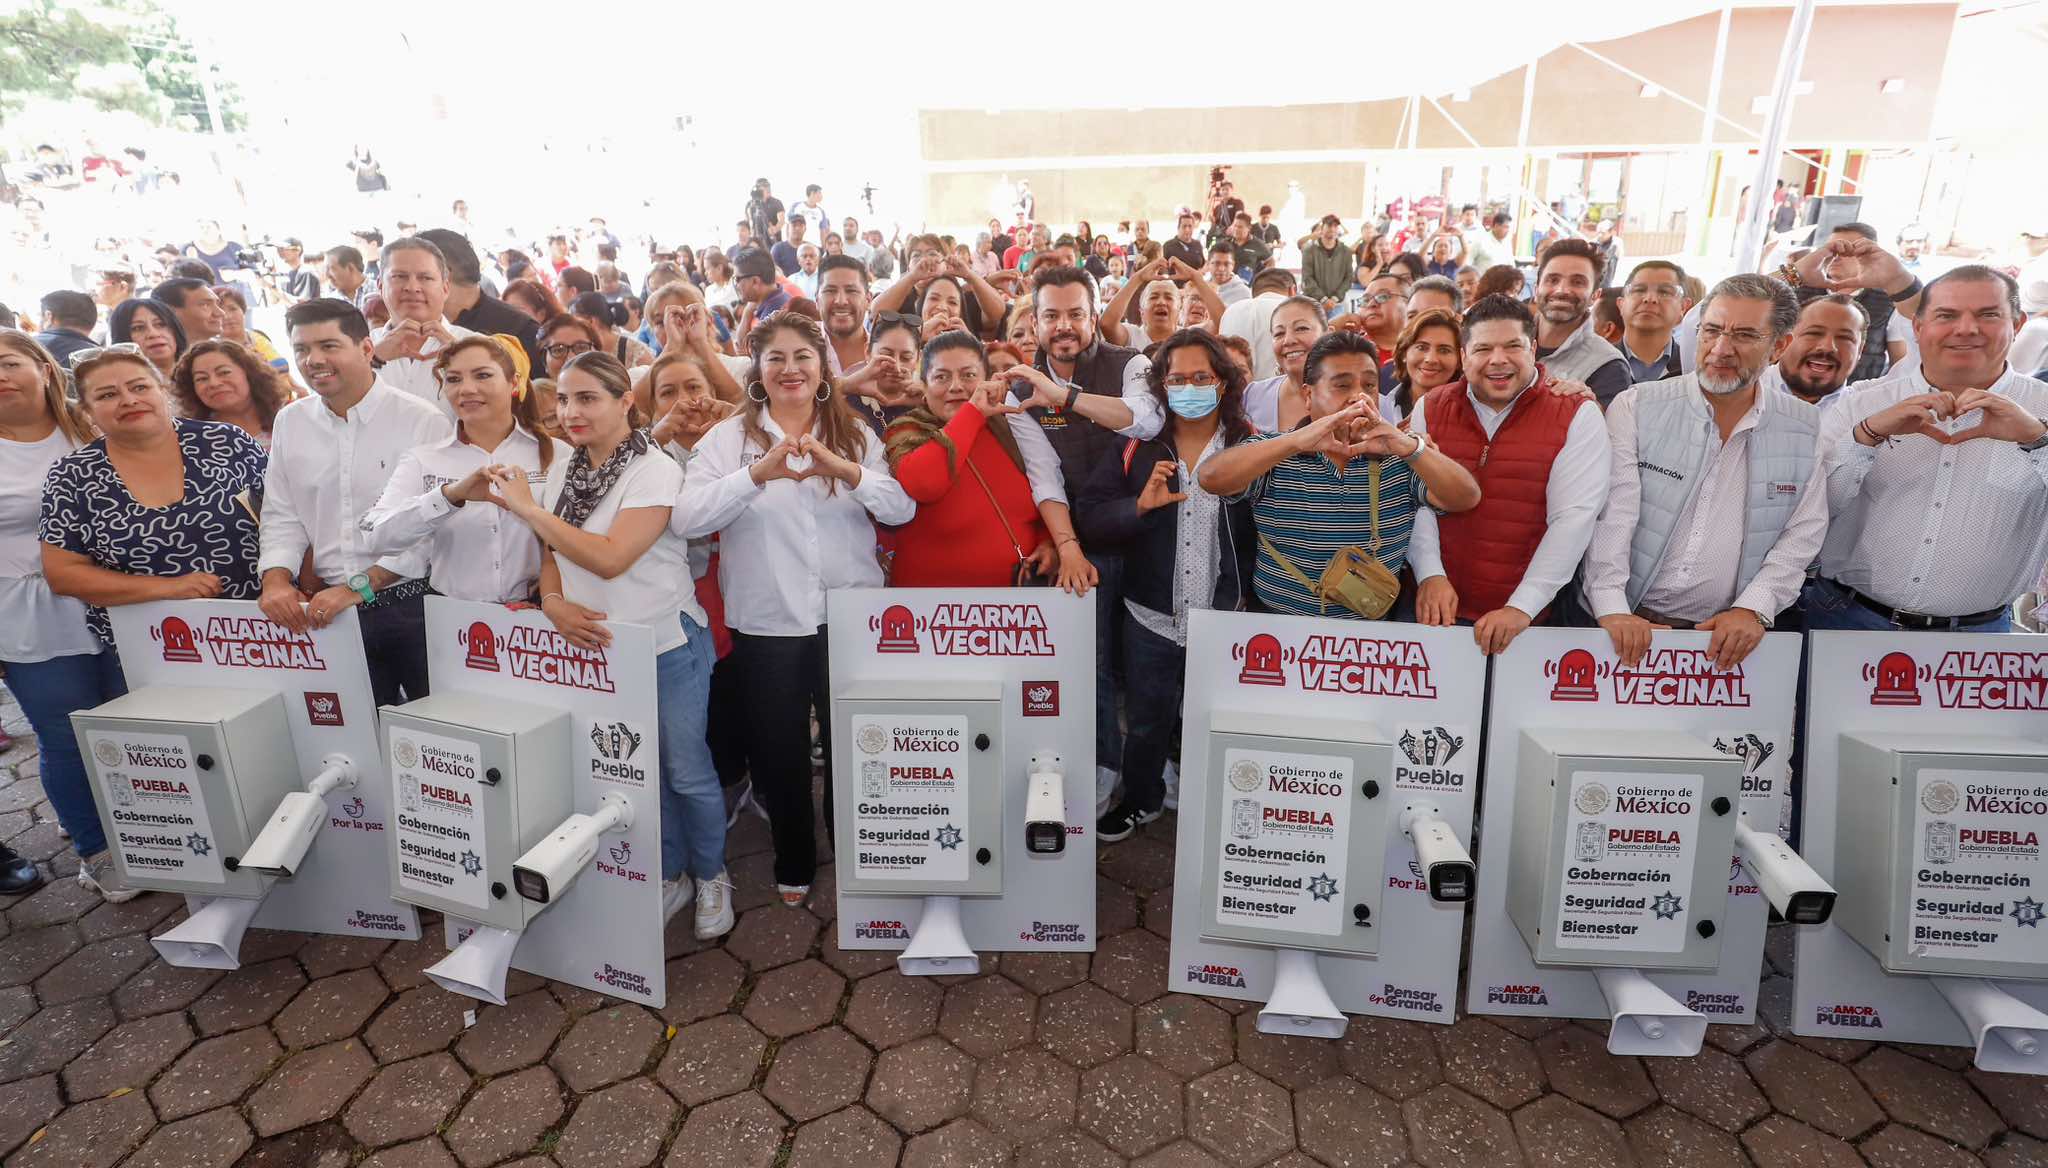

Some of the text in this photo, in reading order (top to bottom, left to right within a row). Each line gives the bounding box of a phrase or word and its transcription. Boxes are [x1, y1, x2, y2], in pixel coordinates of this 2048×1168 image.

[930, 604, 1047, 629] ALARMA
[931, 627, 1055, 655] VECINAL
[208, 639, 326, 670] VECINAL
[1299, 635, 1430, 670] ALARMA
[508, 649, 615, 693] VECINAL
[1934, 651, 2048, 679] ALARM
[1300, 660, 1437, 699] VECINAL
[1614, 675, 1750, 707] VECINAL
[1936, 678, 2048, 709] VECIN
[893, 728, 959, 736] Gobierno de
[124, 743, 183, 755] Gobierno de
[893, 737, 960, 752] México
[127, 752, 187, 768] México
[421, 745, 474, 763] Gobierno de
[422, 755, 474, 779] México
[592, 759, 644, 781] Puebla
[890, 767, 954, 780] PUEBLA
[1269, 765, 1343, 780] Gobierno de
[1396, 767, 1464, 786] Puebla
[1741, 776, 1772, 791] bla
[131, 778, 189, 793] PUEBLA
[1268, 775, 1342, 796] México
[1617, 786, 1692, 797] Gobierno de
[1966, 785, 2048, 797] Gobierno de
[421, 784, 472, 806] PUEBLA
[858, 803, 950, 815] Gobernación
[1616, 797, 1691, 814] México
[1965, 795, 2048, 815] México
[113, 810, 193, 825] Gobernación
[1263, 808, 1333, 826] PUEBLA
[332, 818, 384, 832] Por la paz
[399, 814, 470, 840] Gobernación
[1262, 821, 1296, 830] Gobierno
[1309, 825, 1334, 833] Estado
[120, 833, 182, 846] Seguridad
[859, 829, 930, 842] Seguridad
[1608, 829, 1680, 844] PUEBLA
[1959, 829, 2039, 845] PUEBLA
[400, 839, 456, 862] Seguridad
[1225, 843, 1326, 864] Gobernación
[1608, 842, 1641, 850] Gobierno
[1959, 844, 1996, 852] Gobierno
[2011, 846, 2039, 854] Estado
[125, 854, 184, 867] Bienestar
[859, 853, 927, 865] Bienestar
[402, 862, 454, 885] Bienestar
[597, 861, 647, 882] Por la paz
[1568, 868, 1671, 882] Gobernación
[1918, 870, 2030, 887] Gobernación
[1224, 871, 1302, 889] Seguridad
[1389, 877, 1426, 890] Por la
[1735, 885, 1758, 896] paz
[1223, 896, 1296, 914] Bienestar
[1565, 895, 1646, 909] Seguridad
[1916, 898, 2004, 915] Seguridad
[356, 910, 399, 923] Pensar
[360, 919, 406, 932] Grande
[869, 921, 901, 929] AMOR
[1033, 922, 1080, 933] Pensar
[1563, 920, 1638, 934] Bienestar
[856, 928, 910, 939] PUEBLA
[1036, 931, 1085, 942] Grande
[1915, 926, 1998, 943] Bienestar
[604, 964, 646, 984] Pensar
[1202, 965, 1238, 976] AMOR
[606, 976, 652, 996] Grande
[1188, 971, 1246, 988] PUEBLA
[1384, 984, 1437, 1000] Pensar
[1504, 985, 1540, 993] AMOR
[1385, 995, 1443, 1012] Grande
[1488, 993, 1548, 1005] PUEBLA
[1687, 990, 1740, 1004] Pensar
[1833, 1005, 1873, 1016] AMOR
[1817, 1013, 1882, 1028] PUEBLA
